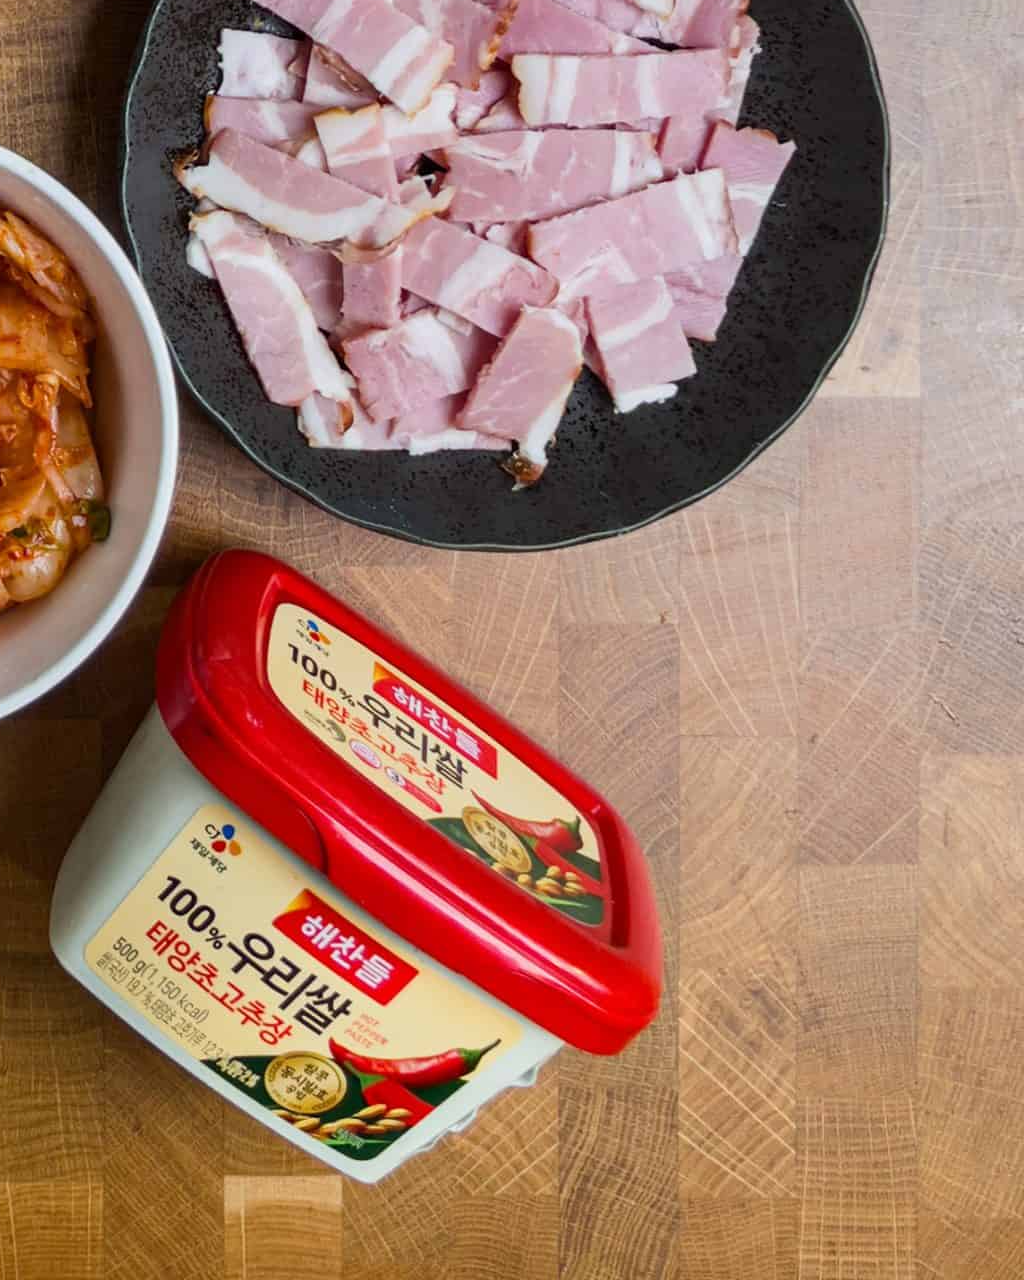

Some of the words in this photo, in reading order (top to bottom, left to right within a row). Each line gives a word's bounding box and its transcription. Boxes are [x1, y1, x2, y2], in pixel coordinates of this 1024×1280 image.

[289, 643, 356, 706] 100%
[357, 694, 467, 788] 우리쌀
[392, 684, 481, 761] 해찬들
[205, 824, 220, 839] CJ
[113, 936, 139, 961] 500
[146, 920, 293, 1046] 태양초고추장
[158, 875, 226, 950] 100%
[226, 933, 351, 1035] 우리쌀
[301, 915, 395, 989] 해찬들
